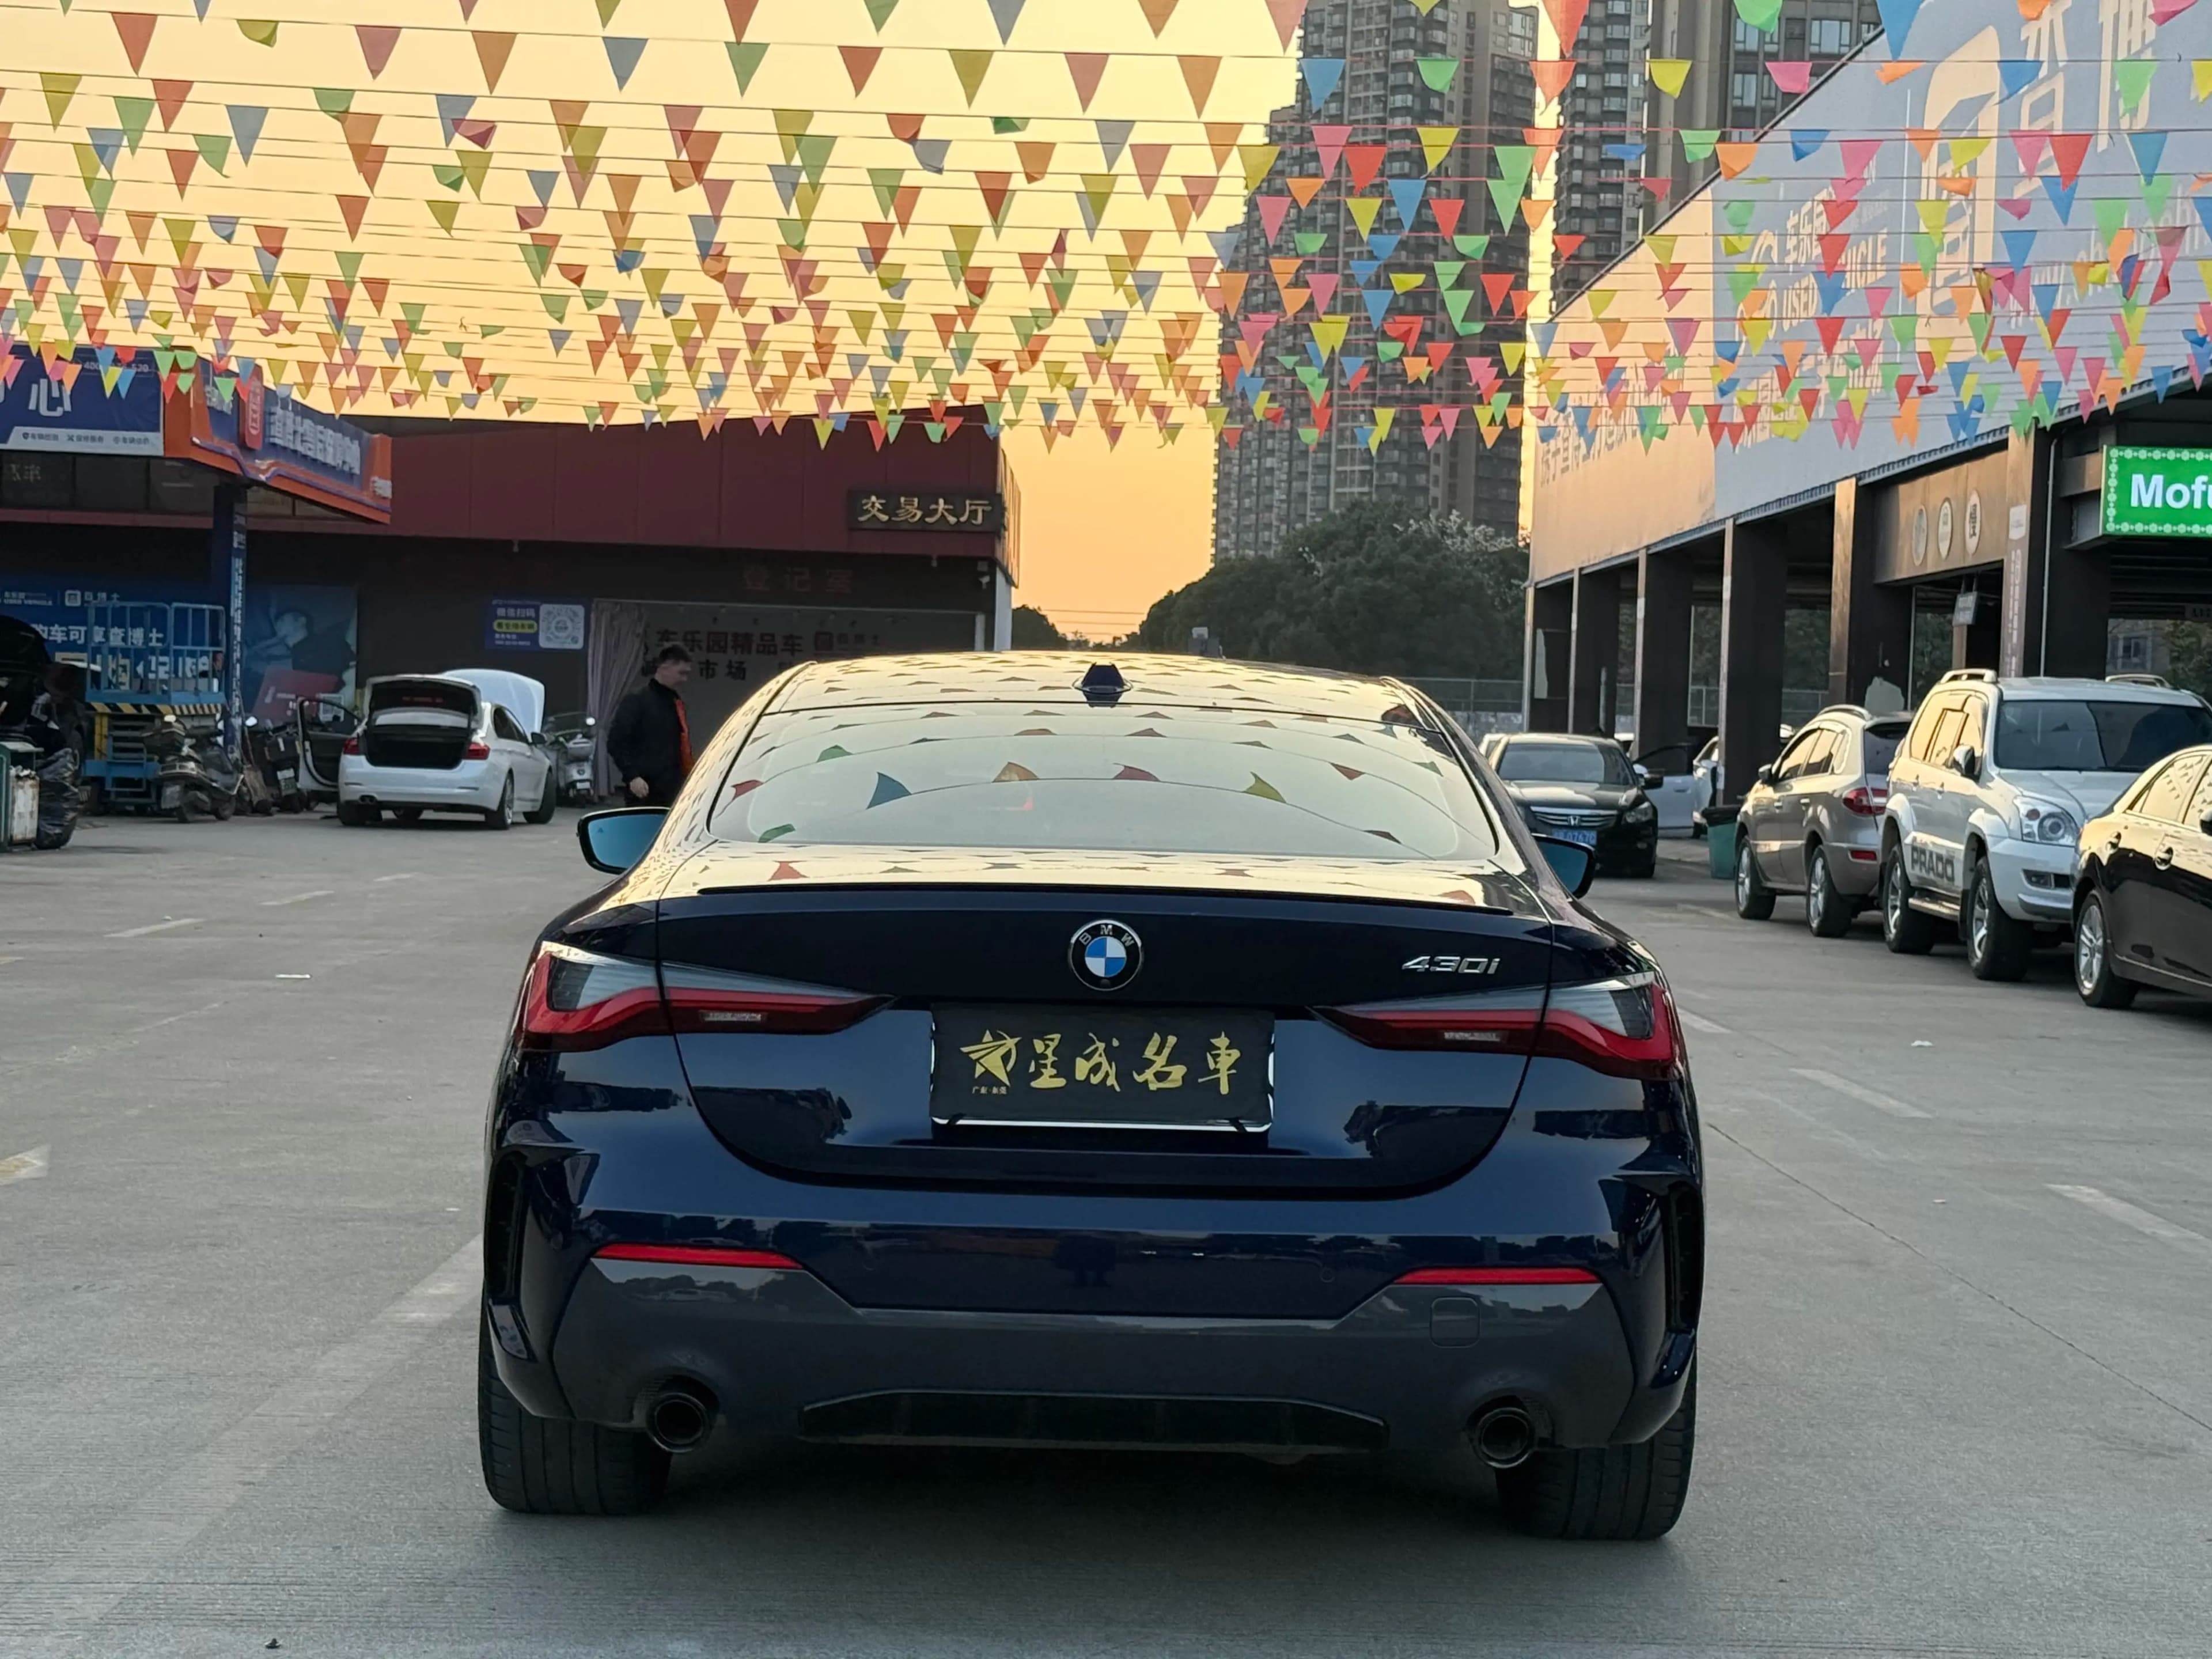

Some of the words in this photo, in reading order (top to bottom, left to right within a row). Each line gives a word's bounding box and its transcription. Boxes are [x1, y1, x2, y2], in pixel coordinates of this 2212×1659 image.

[857, 494, 992, 525] 交易大厅
[1911, 844, 1955, 882] PRADO
[1078, 924, 1135, 946] BMW
[1402, 956, 1501, 975] 430i
